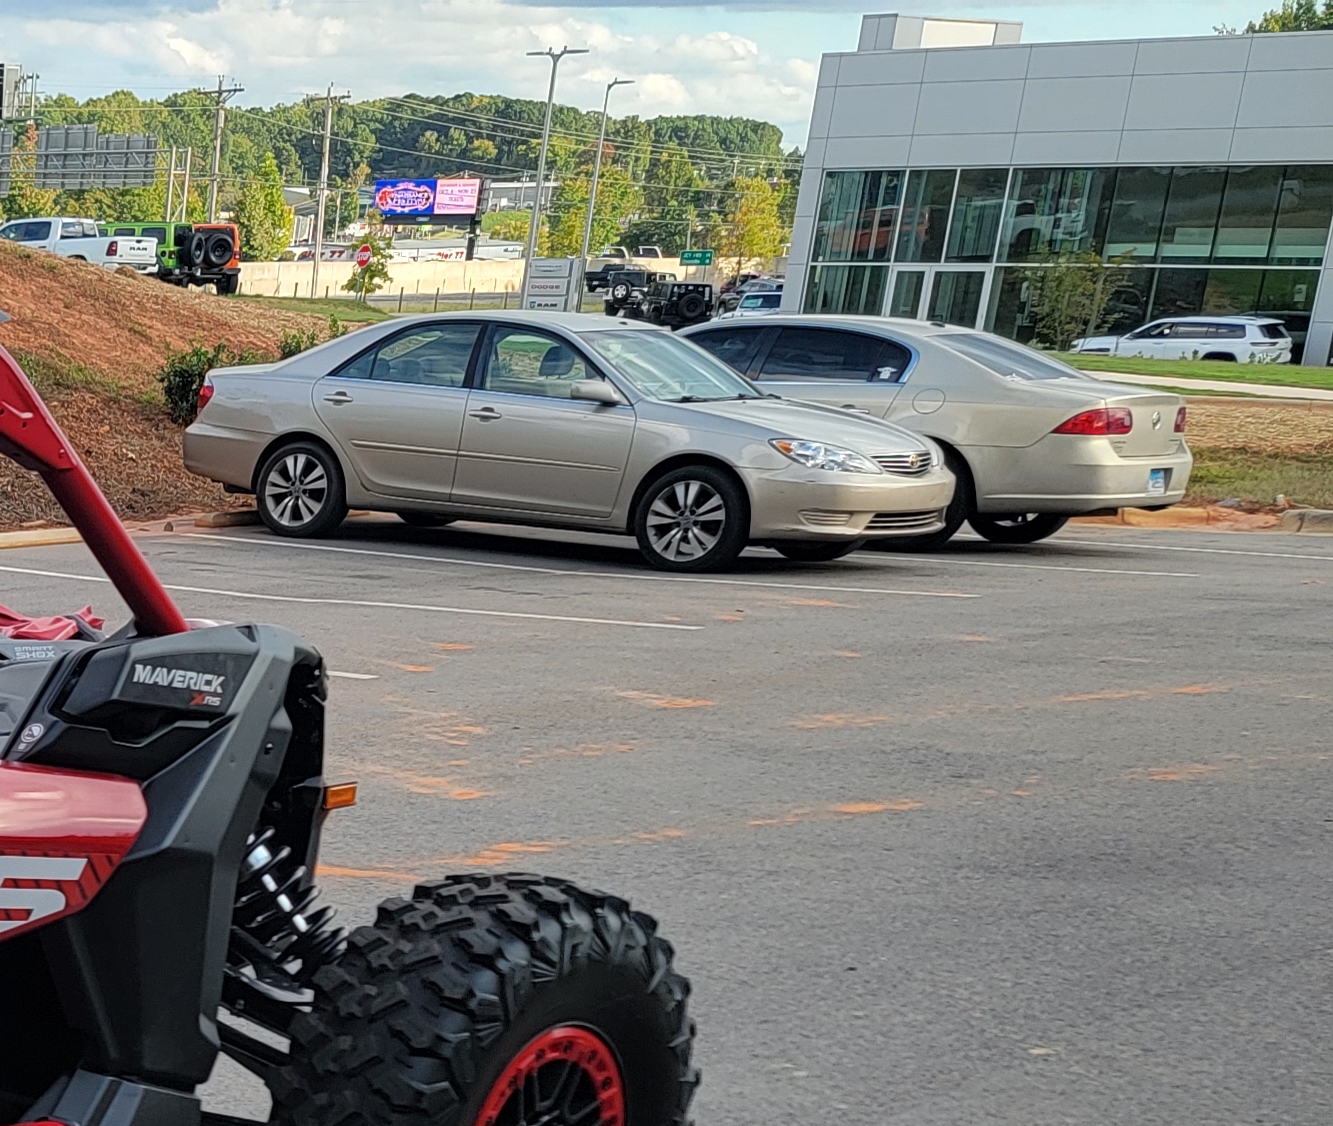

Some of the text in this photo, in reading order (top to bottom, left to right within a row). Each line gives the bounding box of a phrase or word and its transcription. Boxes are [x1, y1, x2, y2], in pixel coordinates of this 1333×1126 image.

[329, 250, 345, 258] 77
[357, 251, 371, 261] STOP
[455, 251, 465, 259] 77
[15, 651, 56, 660] SHOX
[132, 663, 226, 693] MAVERICK
